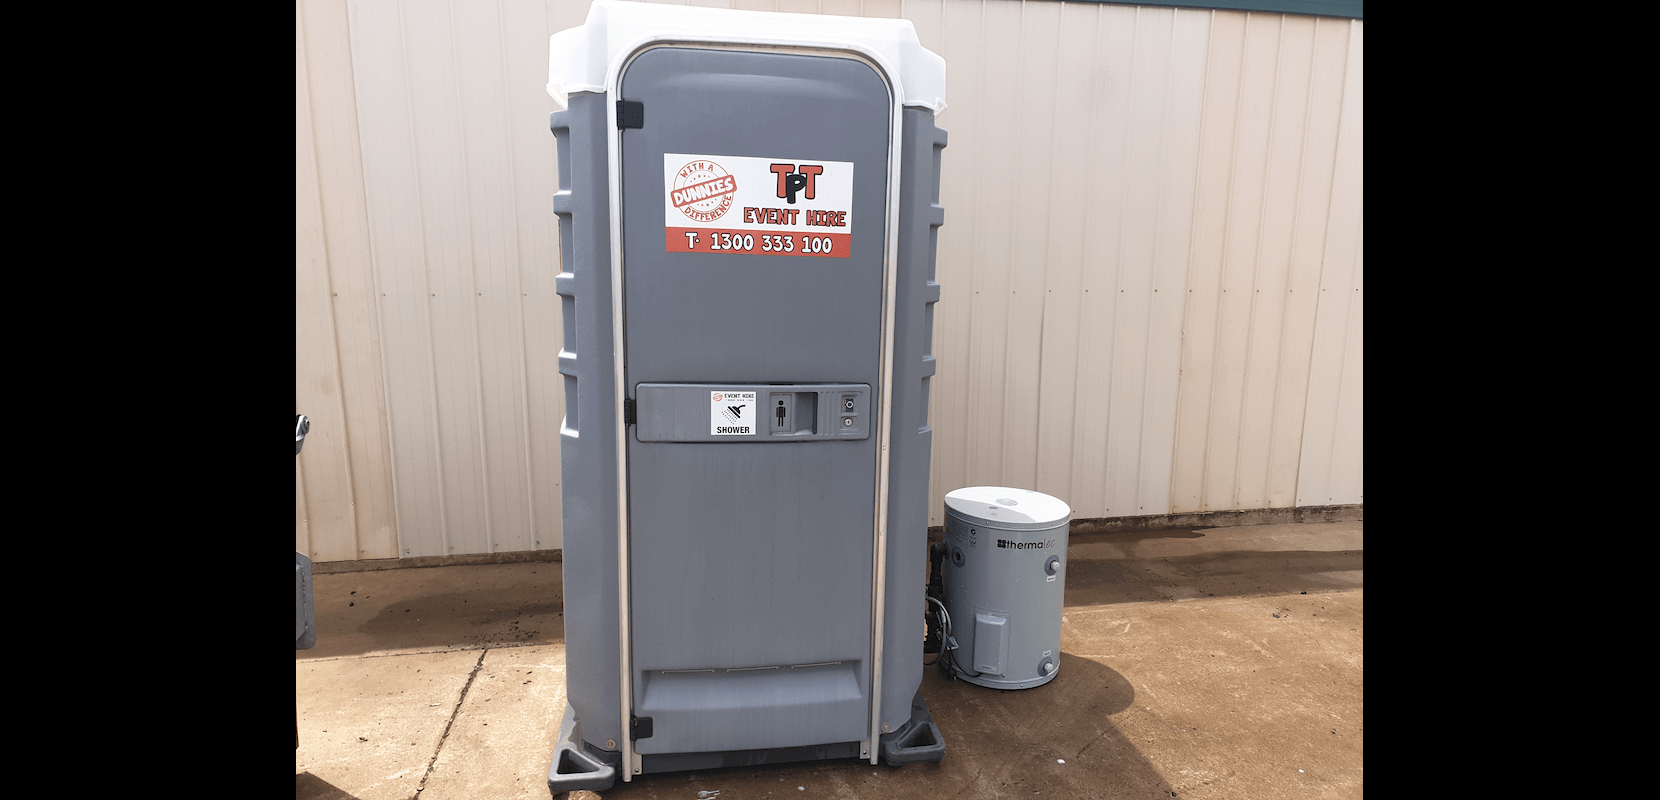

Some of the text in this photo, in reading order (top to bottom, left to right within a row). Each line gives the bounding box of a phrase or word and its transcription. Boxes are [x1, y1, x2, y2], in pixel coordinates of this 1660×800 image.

[680, 162, 714, 178] WITH A
[673, 177, 734, 206] DUNNIES
[684, 194, 732, 221] DIFFERENCE
[743, 206, 847, 227] EVENT HIRE
[710, 232, 755, 251] 1300
[761, 234, 795, 253] 333
[801, 236, 833, 254] 100
[717, 426, 750, 434] SHOWER
